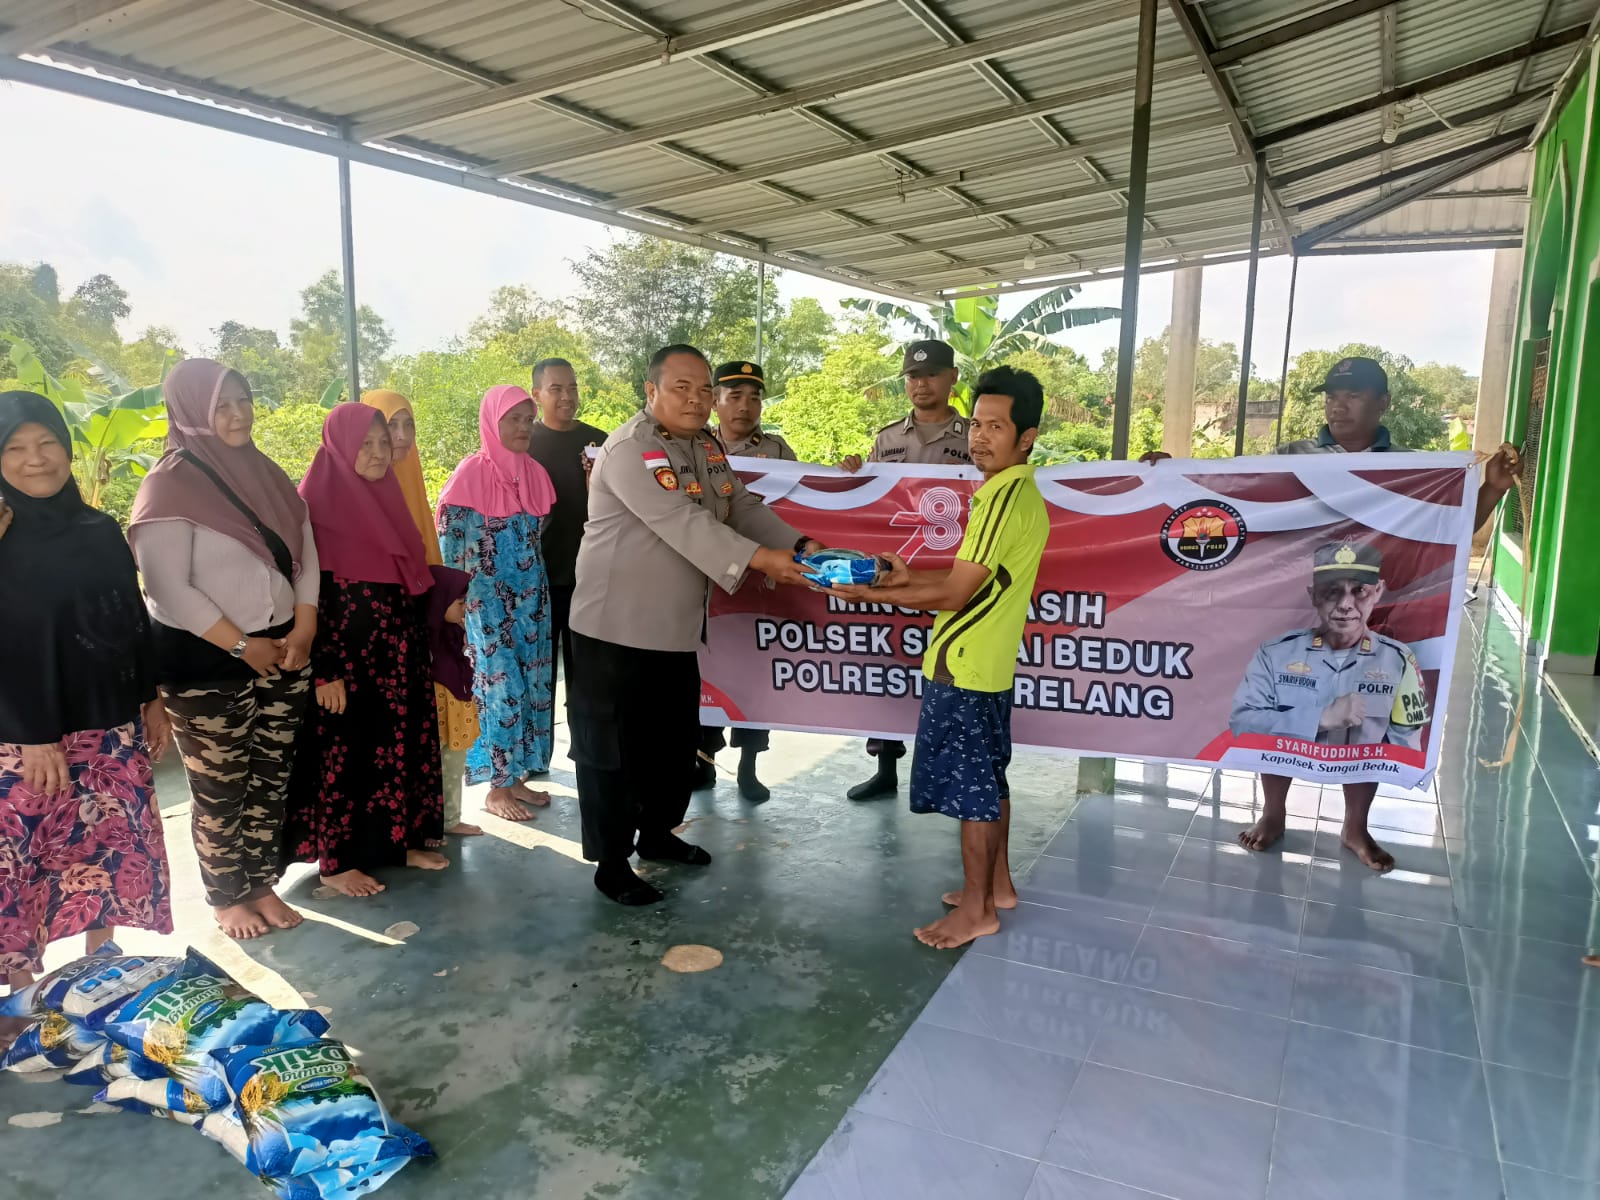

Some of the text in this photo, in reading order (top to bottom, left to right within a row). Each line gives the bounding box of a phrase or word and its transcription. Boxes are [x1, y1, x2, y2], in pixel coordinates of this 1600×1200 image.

[756, 620, 894, 655] POLSEK
[1054, 637, 1190, 676] BEDUK
[774, 660, 1172, 717] POLREST RELANG
[1277, 674, 1317, 689] SYARIFUDDIN
[1357, 682, 1394, 695] POLRI
[1276, 738, 1388, 758] SYARIFUDDIN S.H.
[1261, 752, 1401, 774] Kapolsek Sungai Beduk
[249, 1045, 351, 1076] Daik
[280, 1063, 347, 1083] Gunung
